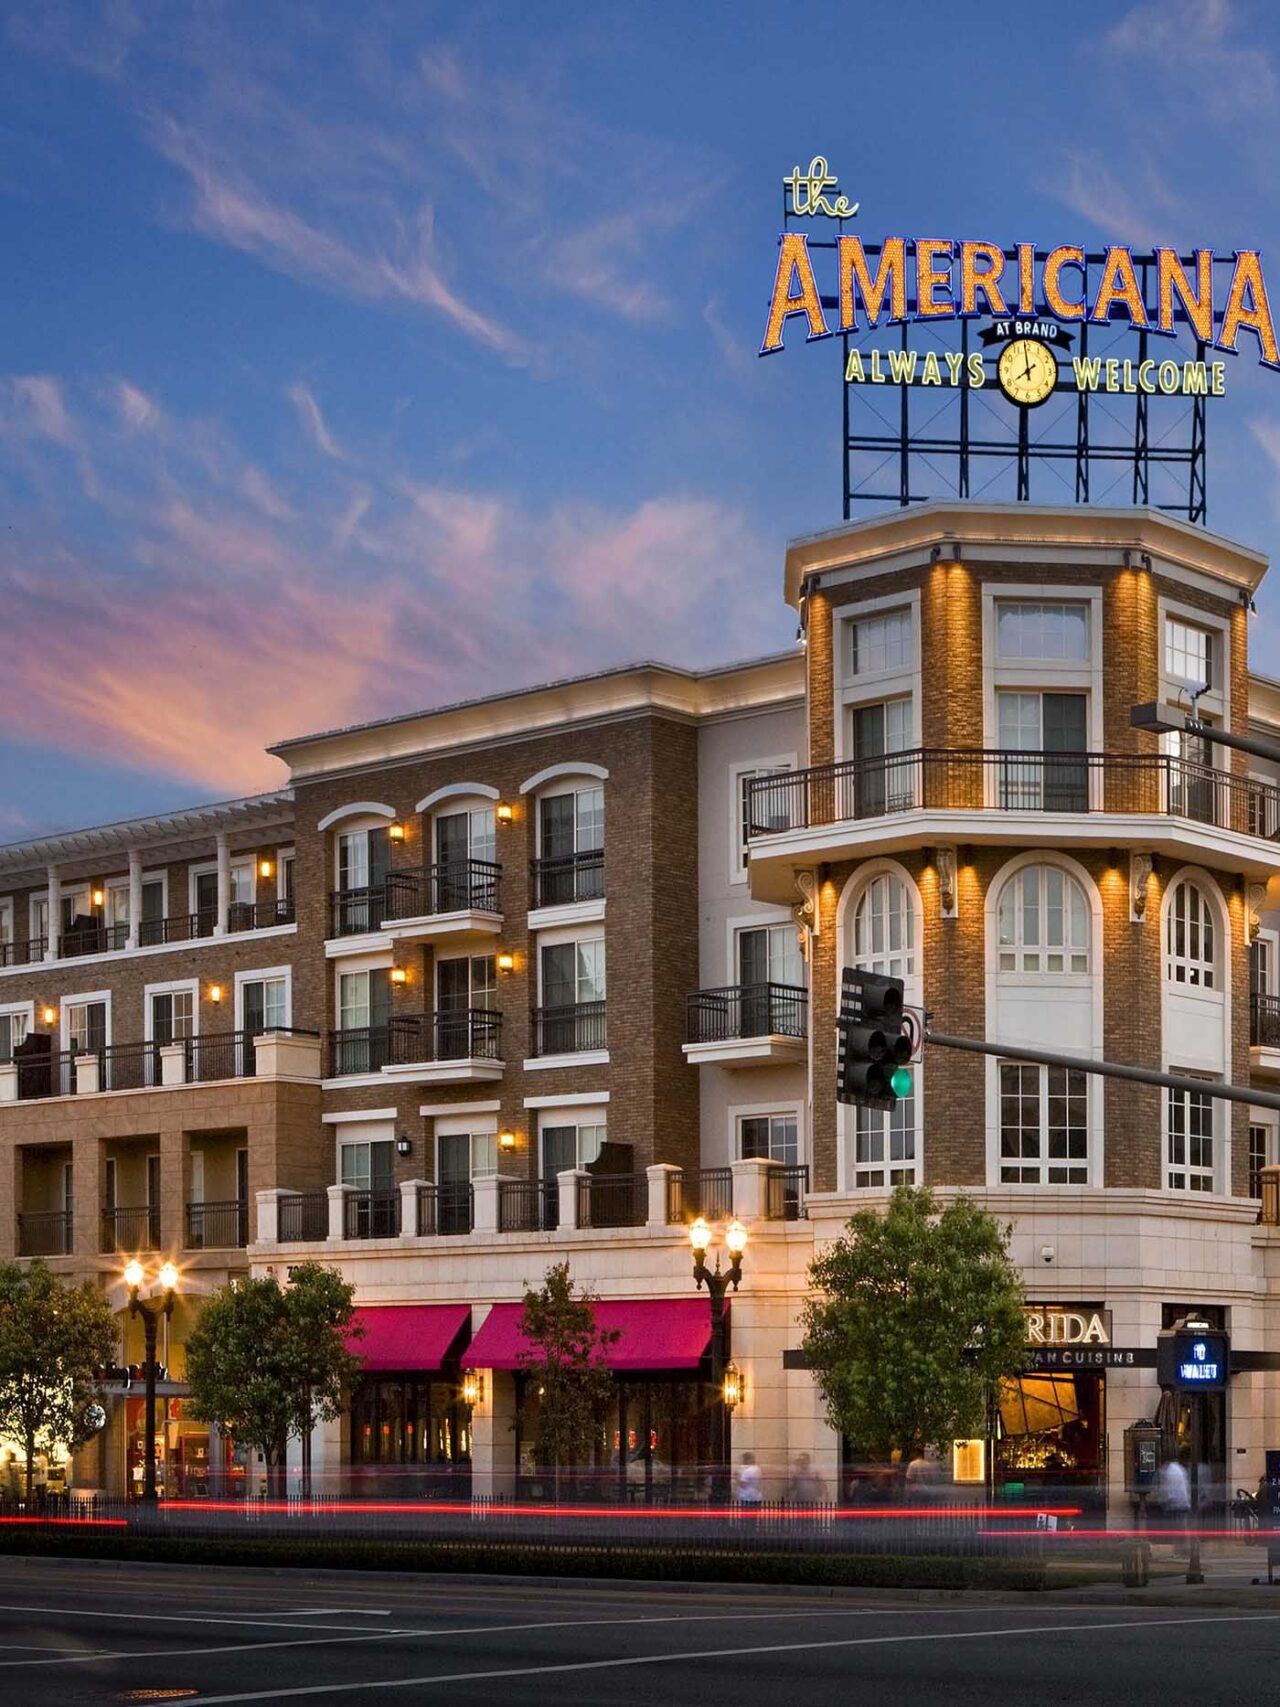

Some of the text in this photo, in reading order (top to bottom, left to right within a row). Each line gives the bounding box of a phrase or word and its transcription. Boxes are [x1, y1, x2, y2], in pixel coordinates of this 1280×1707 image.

[783, 155, 860, 218] the
[997, 322, 1057, 337] AT BRAND
[845, 348, 1226, 395] ALWAYS WELCOME
[1024, 1313, 1110, 1343] RIDA
[1272, 1478, 1277, 1486] 2
